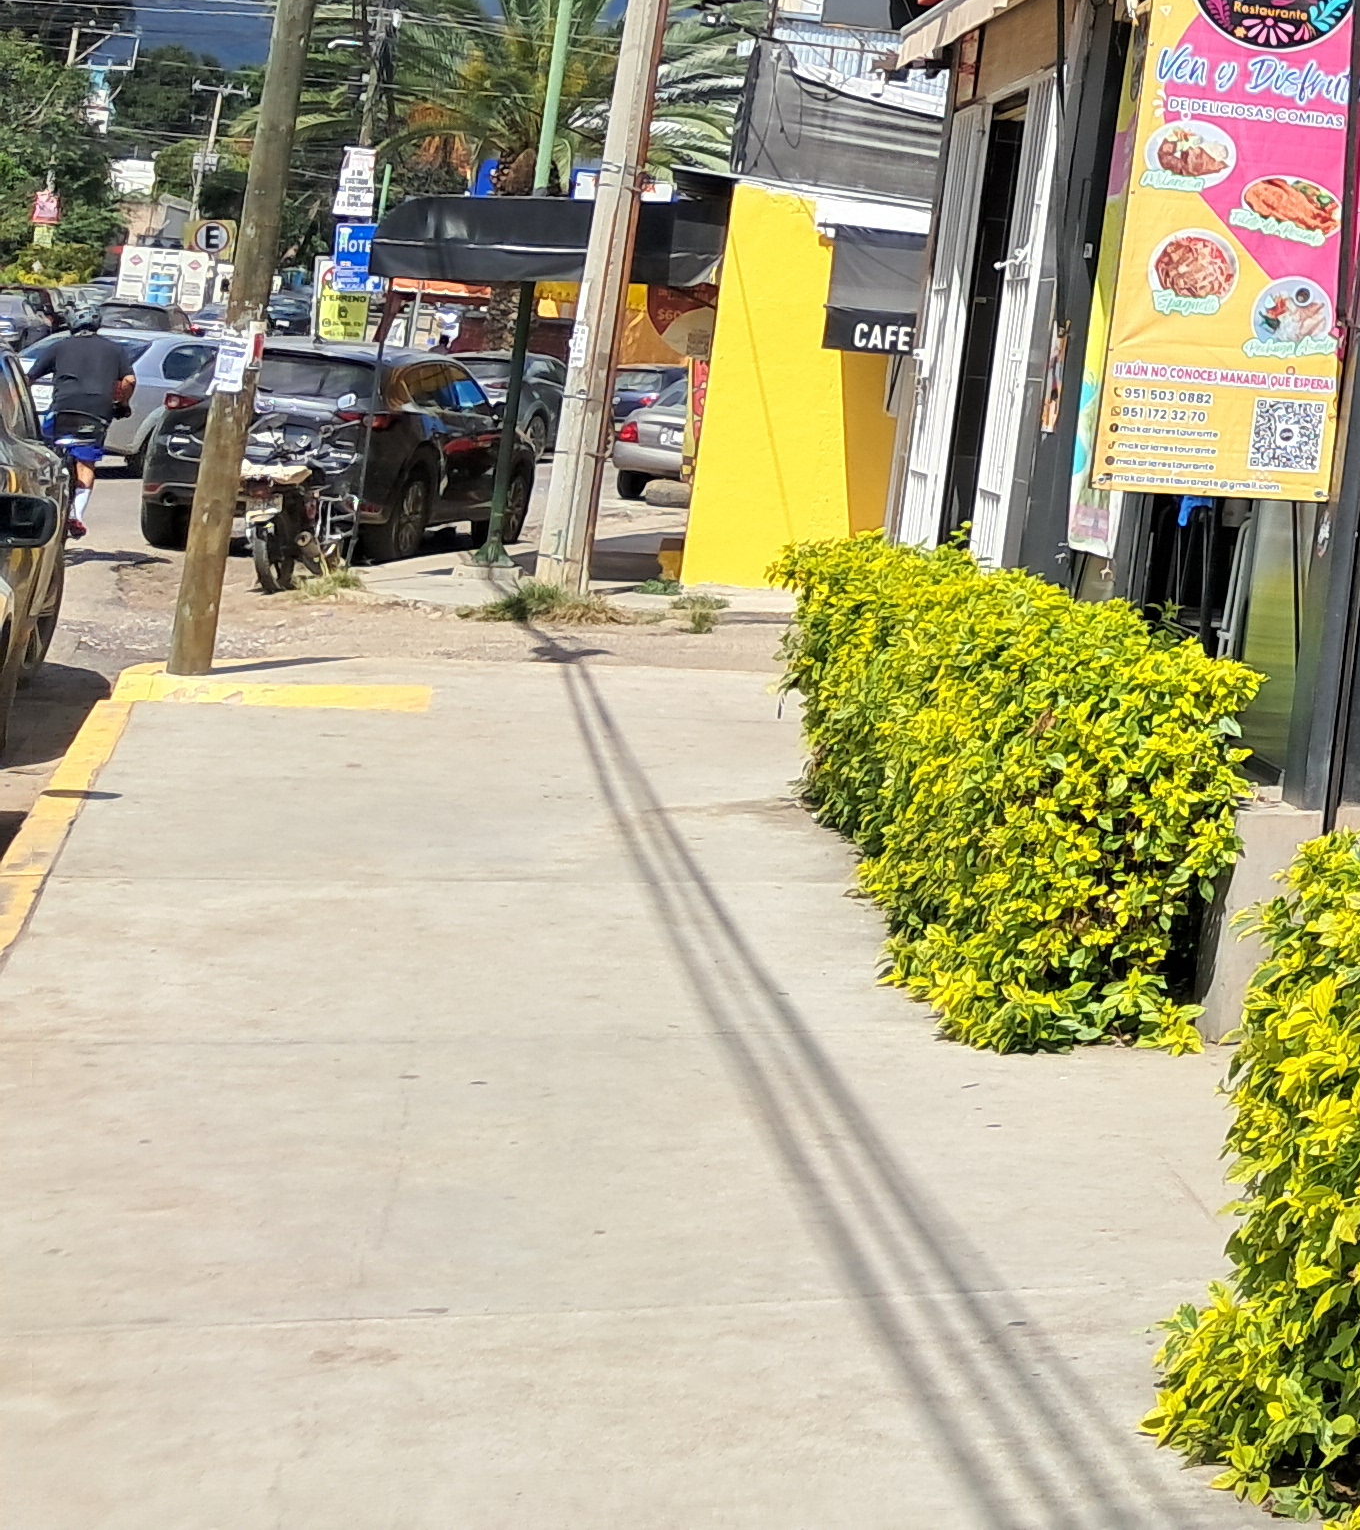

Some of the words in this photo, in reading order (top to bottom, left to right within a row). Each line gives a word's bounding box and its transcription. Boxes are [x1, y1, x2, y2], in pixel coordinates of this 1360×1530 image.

[1234, 1, 1308, 20] Restaurante
[1159, 49, 1206, 85] Ven
[1218, 61, 1236, 91] y
[1170, 99, 1187, 109] DE
[1192, 101, 1273, 119] DELICIOSAS
[1276, 112, 1343, 127] COMIDAS
[205, 226, 220, 249] E
[1151, 367, 1167, 378] NO
[1170, 368, 1217, 382] CONOCES
[1221, 372, 1267, 385] MAKARIA
[1271, 376, 1290, 387] QUE
[1294, 378, 1334, 389] ESPERAS
[1125, 389, 1146, 399] 951
[1151, 391, 1176, 401] 503
[1179, 392, 1211, 404] 0882
[1122, 407, 1142, 418] 951
[1148, 409, 1166, 419] 172
[1171, 411, 1186, 420] 32
[1191, 412, 1206, 422] 70
